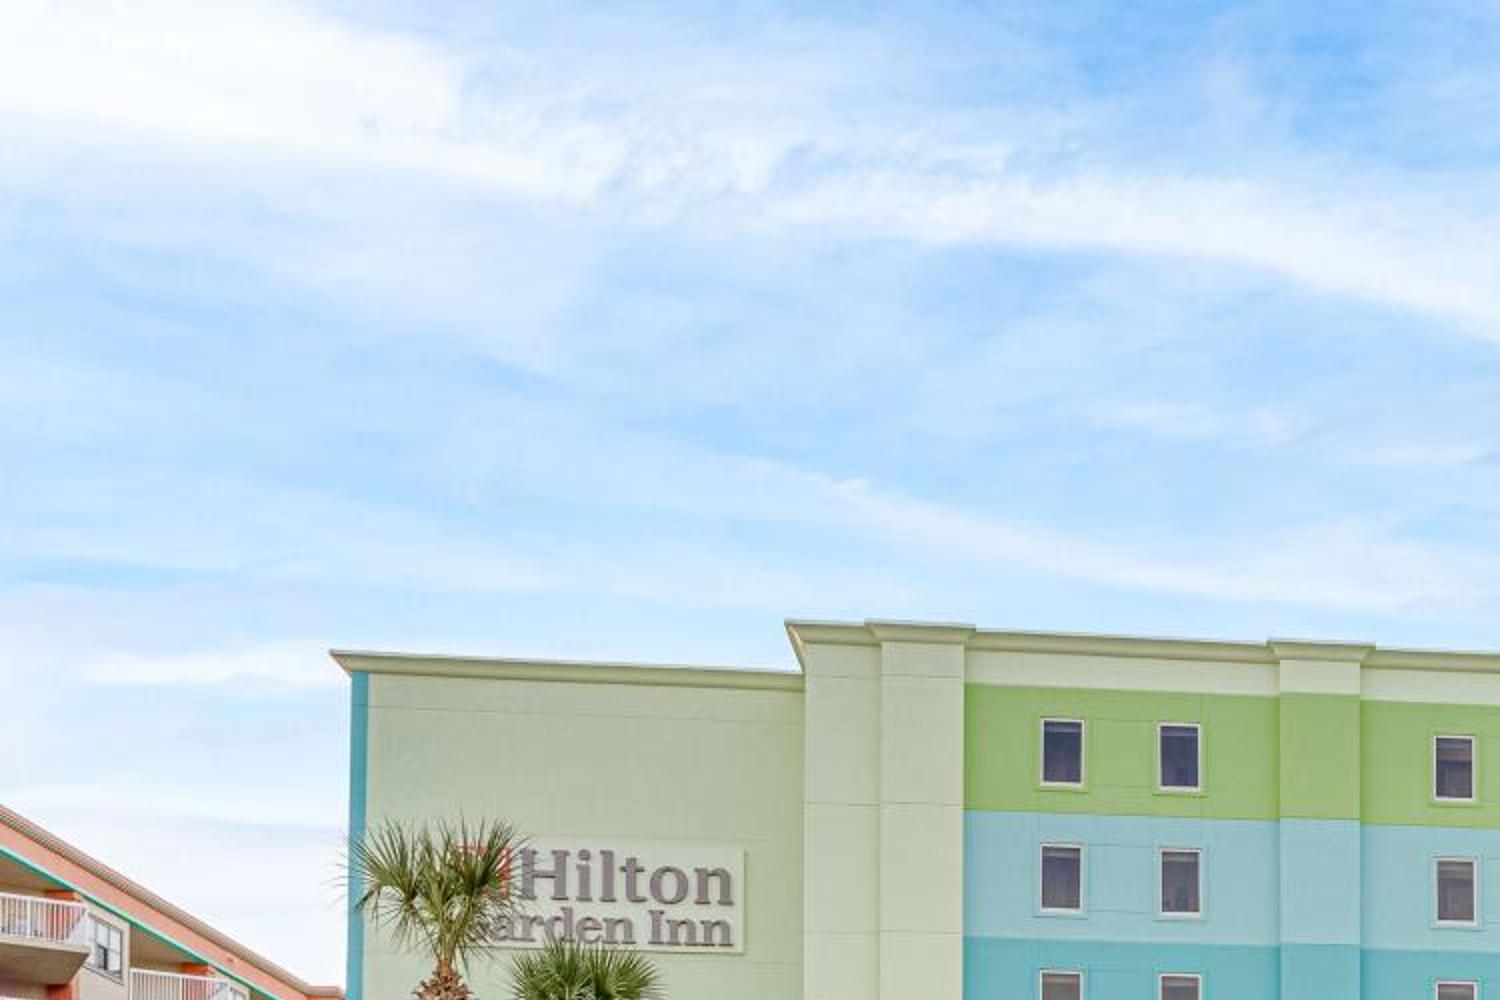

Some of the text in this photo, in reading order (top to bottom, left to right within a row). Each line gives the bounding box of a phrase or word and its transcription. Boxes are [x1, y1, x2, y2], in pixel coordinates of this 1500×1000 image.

[519, 849, 734, 906] Hilton
[479, 906, 734, 946] arden Inn
